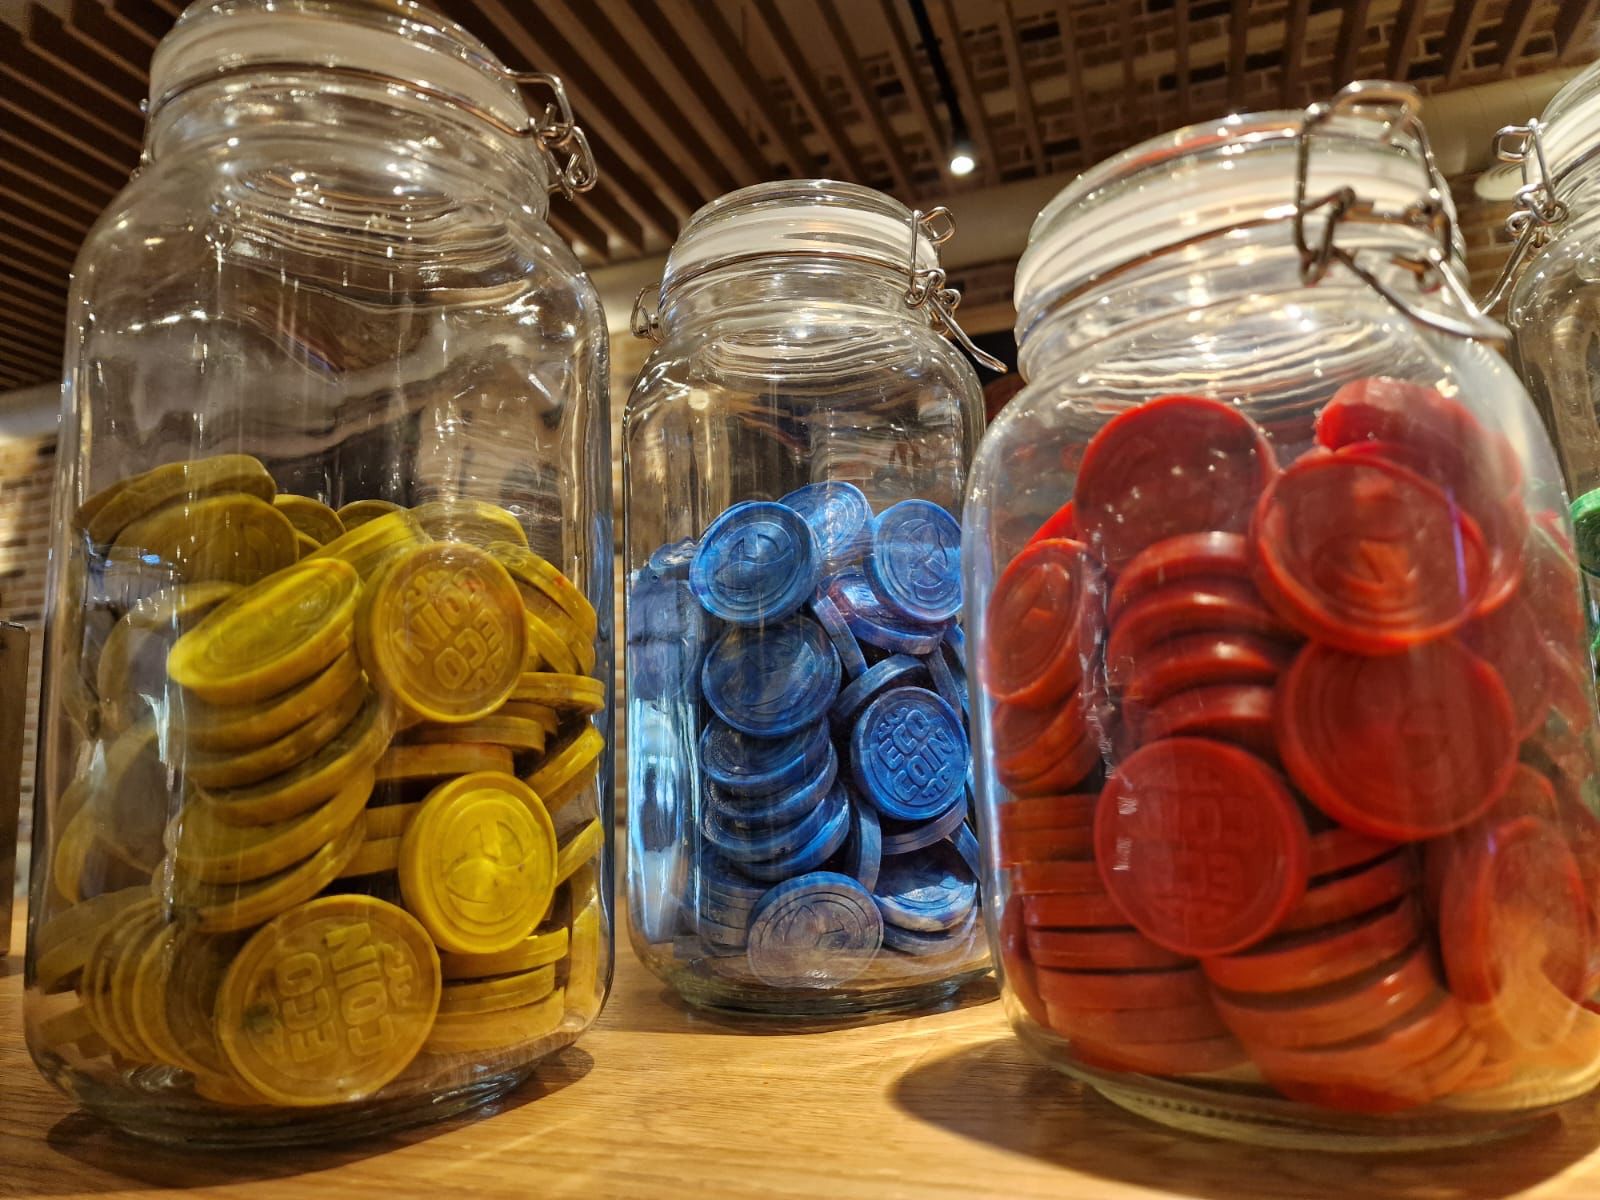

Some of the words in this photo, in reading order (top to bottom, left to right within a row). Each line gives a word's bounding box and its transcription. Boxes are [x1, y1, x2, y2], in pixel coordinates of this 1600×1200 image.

[394, 566, 486, 665] COIN
[432, 608, 505, 690] ECO
[878, 709, 930, 770] ECO
[893, 727, 955, 802] COIN
[274, 950, 337, 1063] ECO
[324, 922, 394, 1057] COIN
